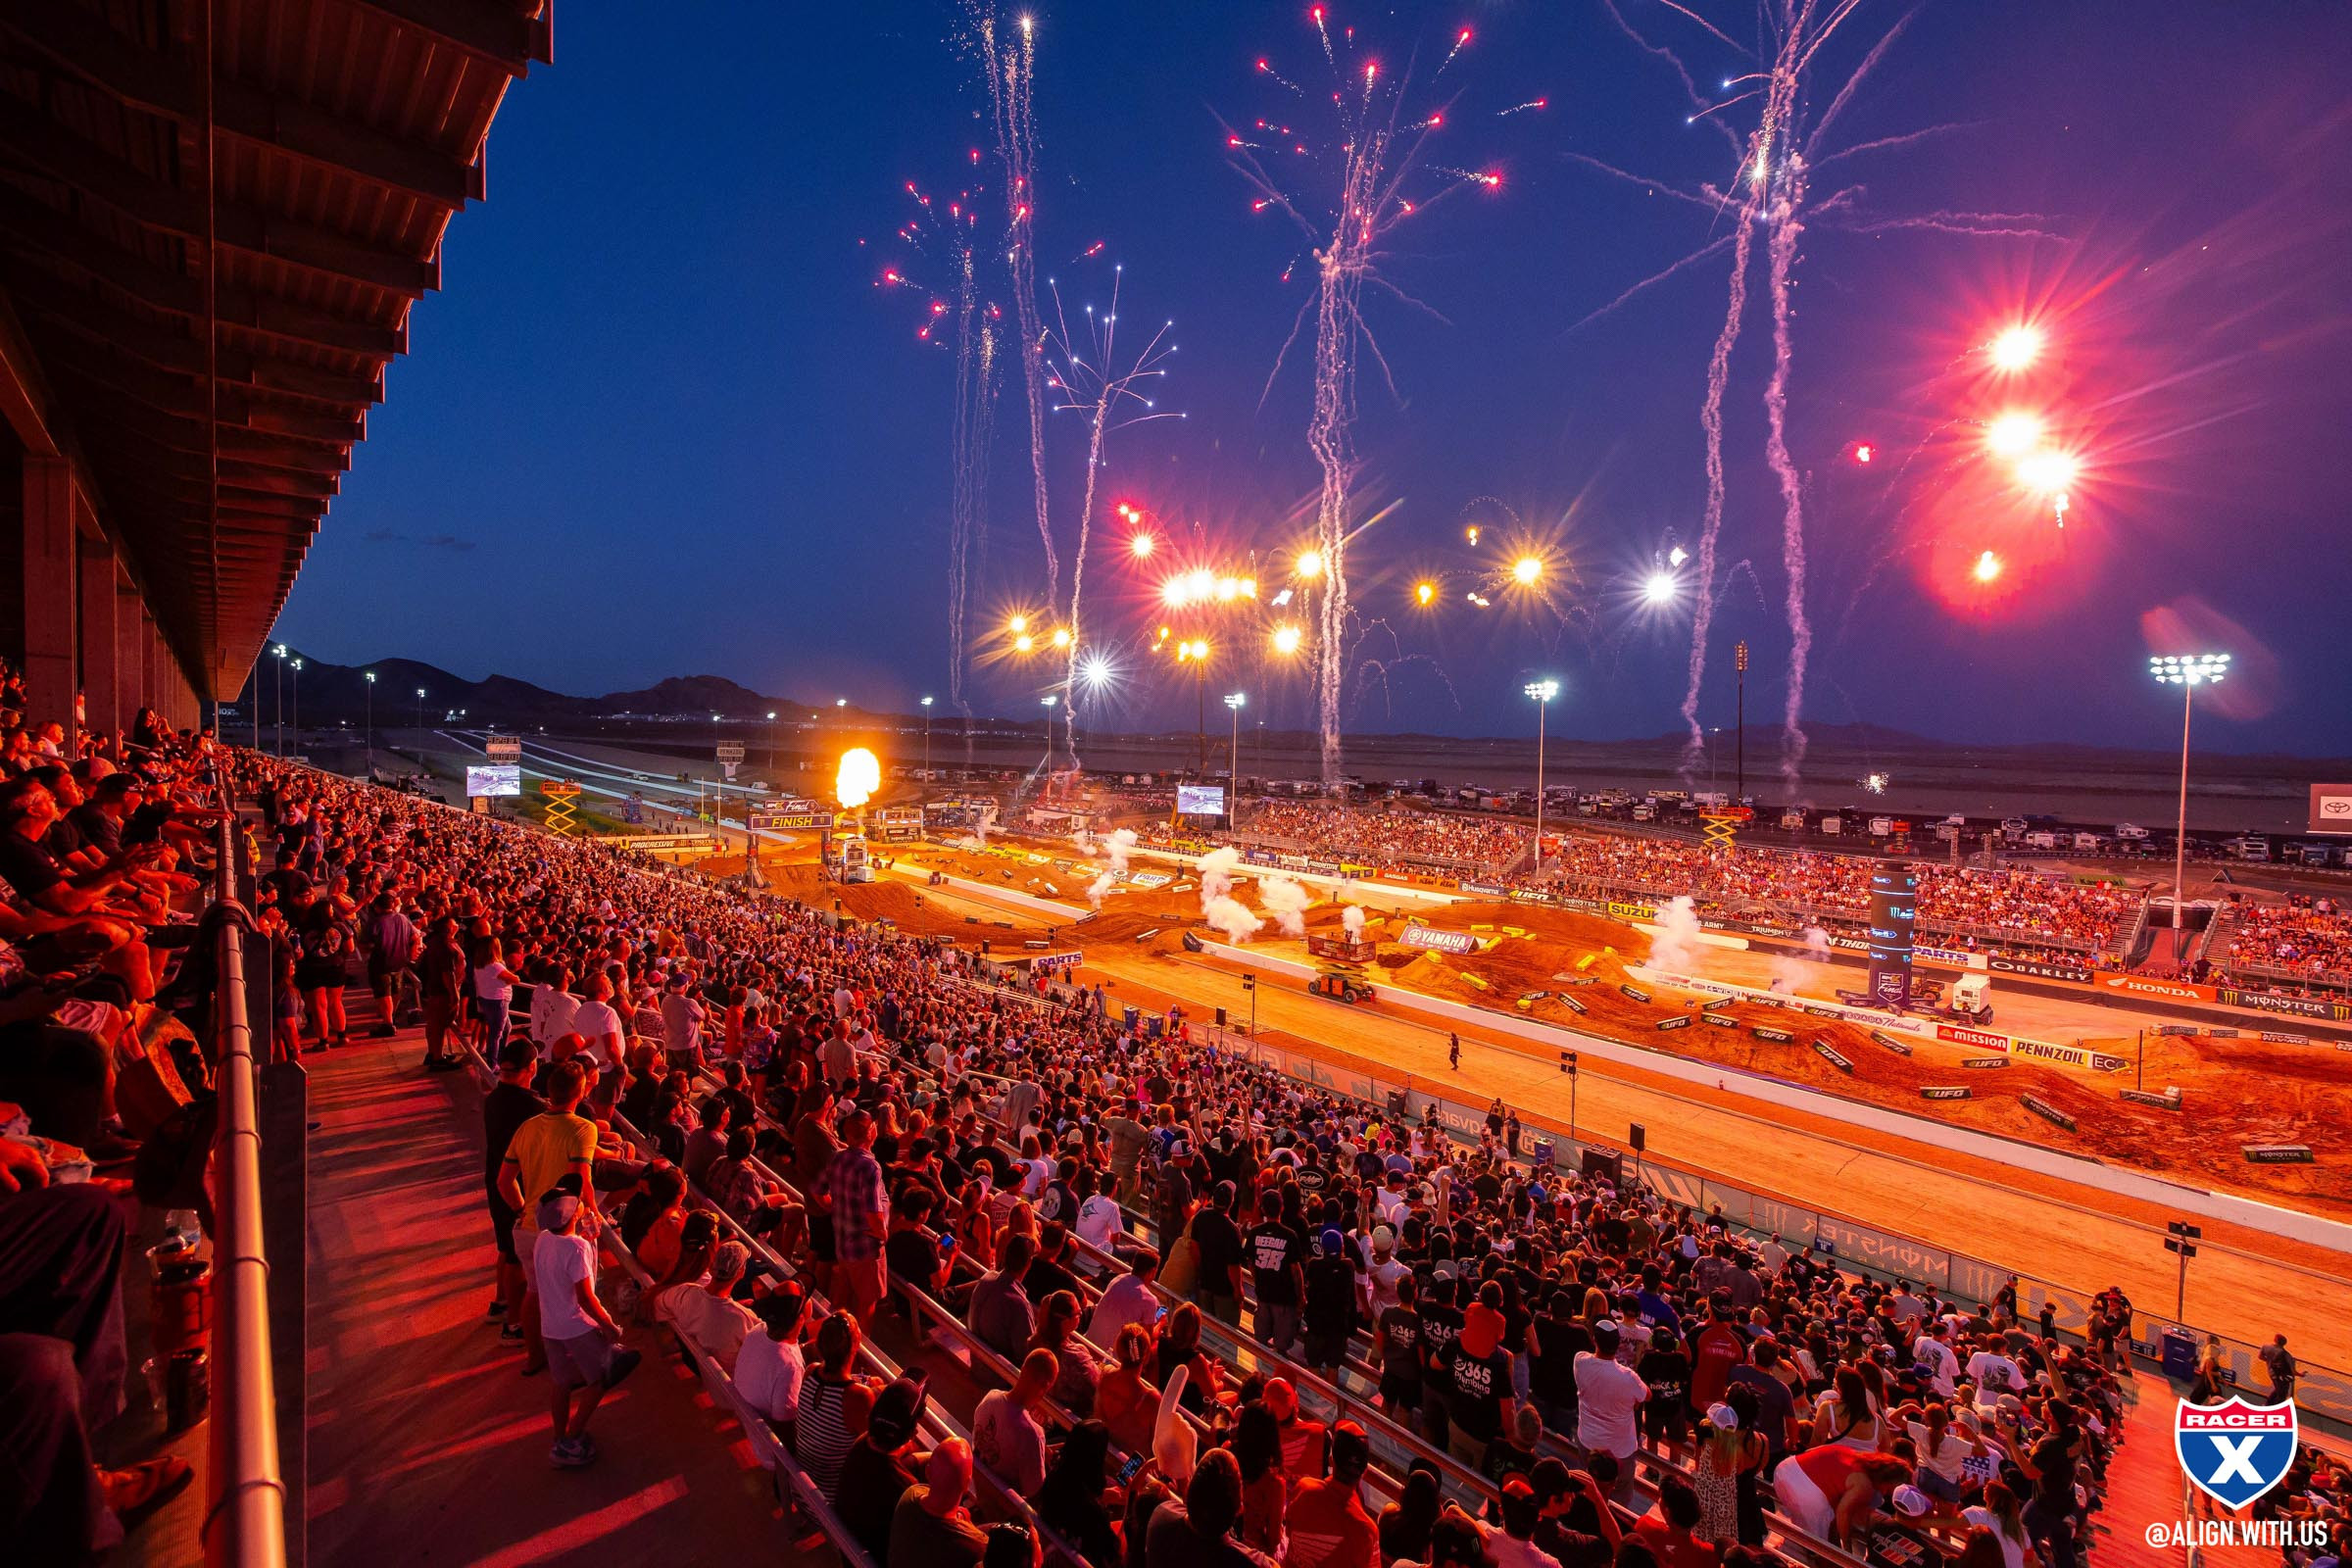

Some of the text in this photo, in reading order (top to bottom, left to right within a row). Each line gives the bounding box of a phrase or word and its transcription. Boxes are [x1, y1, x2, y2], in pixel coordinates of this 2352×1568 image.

[785, 799, 809, 812] Final
[771, 816, 813, 827] FINISH
[630, 840, 676, 849] PROGRESSIVE
[1384, 872, 1408, 881] GASGAS
[1419, 877, 1435, 886] KTM
[1440, 880, 1456, 889] KTM
[1468, 884, 1499, 895] Husqvarna
[1564, 898, 1597, 907] MONSTER
[1611, 905, 1658, 919] SUZUK
[1750, 925, 1785, 936] TRIUMPH
[1421, 931, 1466, 948] YAMAHA
[1912, 946, 1968, 960] PARTS
[2017, 964, 2089, 981] OAKLEY
[2128, 981, 2200, 999] HONDA
[1527, 992, 1544, 1001] UFO
[1628, 990, 1646, 1002] UFO
[1564, 1000, 1581, 1011] UFO
[1711, 1000, 1730, 1009] UFO
[1756, 998, 1778, 1007] UFO
[2245, 995, 2326, 1013] MONSTER
[1813, 1008, 1838, 1019] UFO
[2256, 1005, 2314, 1018] ENERGY
[1666, 1019, 1686, 1029] UFO
[1710, 1016, 1733, 1027] UFO
[1762, 1030, 1787, 1042] UFO
[1880, 1039, 1905, 1054] UFO
[1821, 1049, 1847, 1067] UFO
[2015, 1042, 2085, 1065] PENNZOIL
[1974, 1059, 2003, 1068] UFO
[1934, 1089, 1964, 1099] UFO
[2130, 1093, 2165, 1104] MONSTER
[1254, 1248, 1286, 1272] 38
[1397, 1325, 1416, 1339] 365
[1465, 1360, 1492, 1385] 365
[1454, 1371, 1491, 1396] Plumbing
